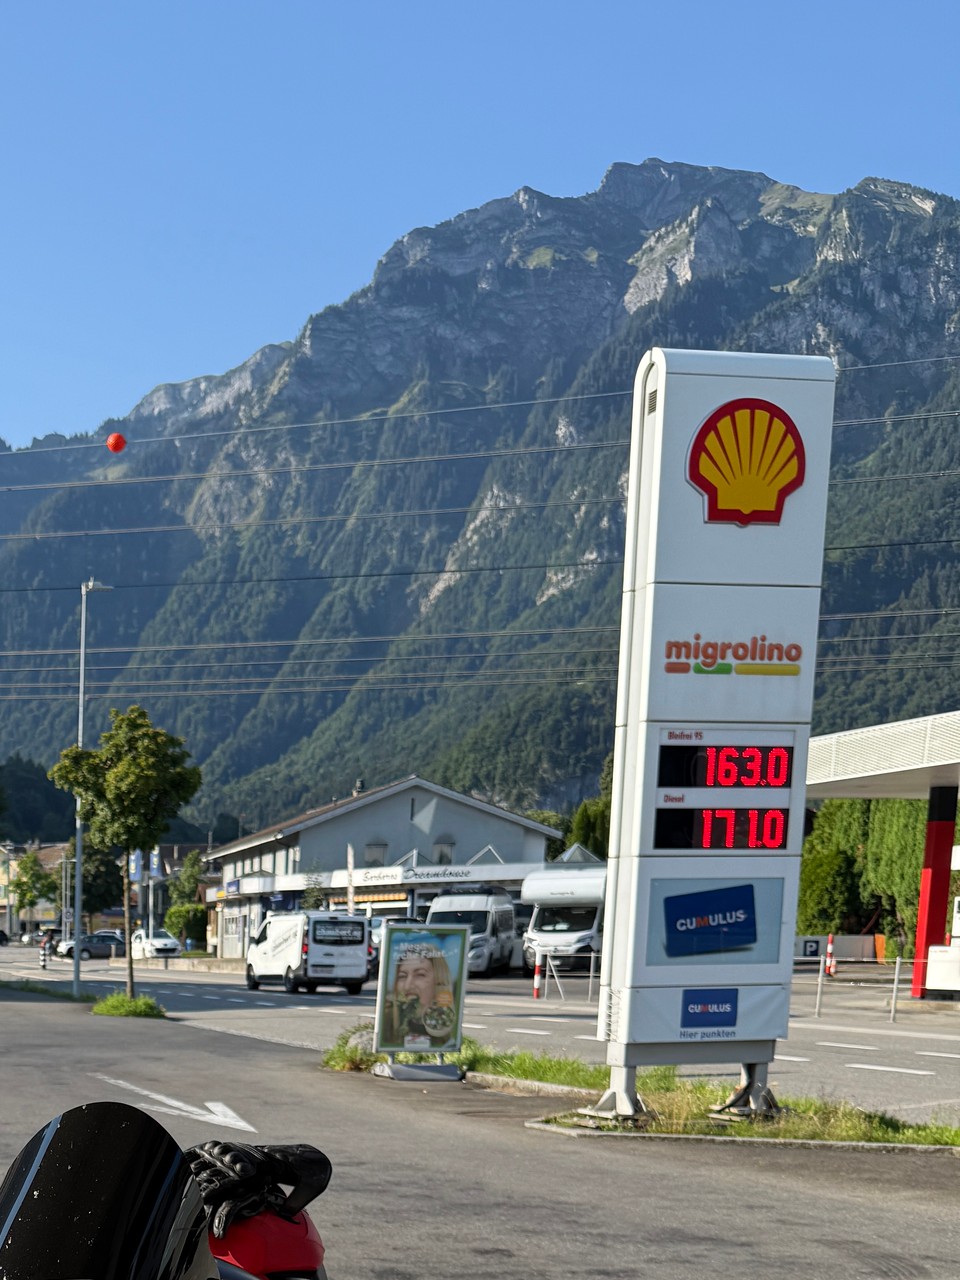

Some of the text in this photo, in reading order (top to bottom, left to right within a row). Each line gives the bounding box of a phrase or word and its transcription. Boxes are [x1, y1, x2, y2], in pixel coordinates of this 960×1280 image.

[665, 633, 802, 668] migrolino
[668, 731, 704, 740] Bleifrei 95
[706, 747, 789, 786] 163.0
[664, 794, 684, 803] Diesel
[702, 810, 785, 848] 171.0
[676, 909, 746, 931] CUMULUS
[688, 1003, 732, 1013] CUMULUS
[680, 1030, 736, 1040] Hier punkten
